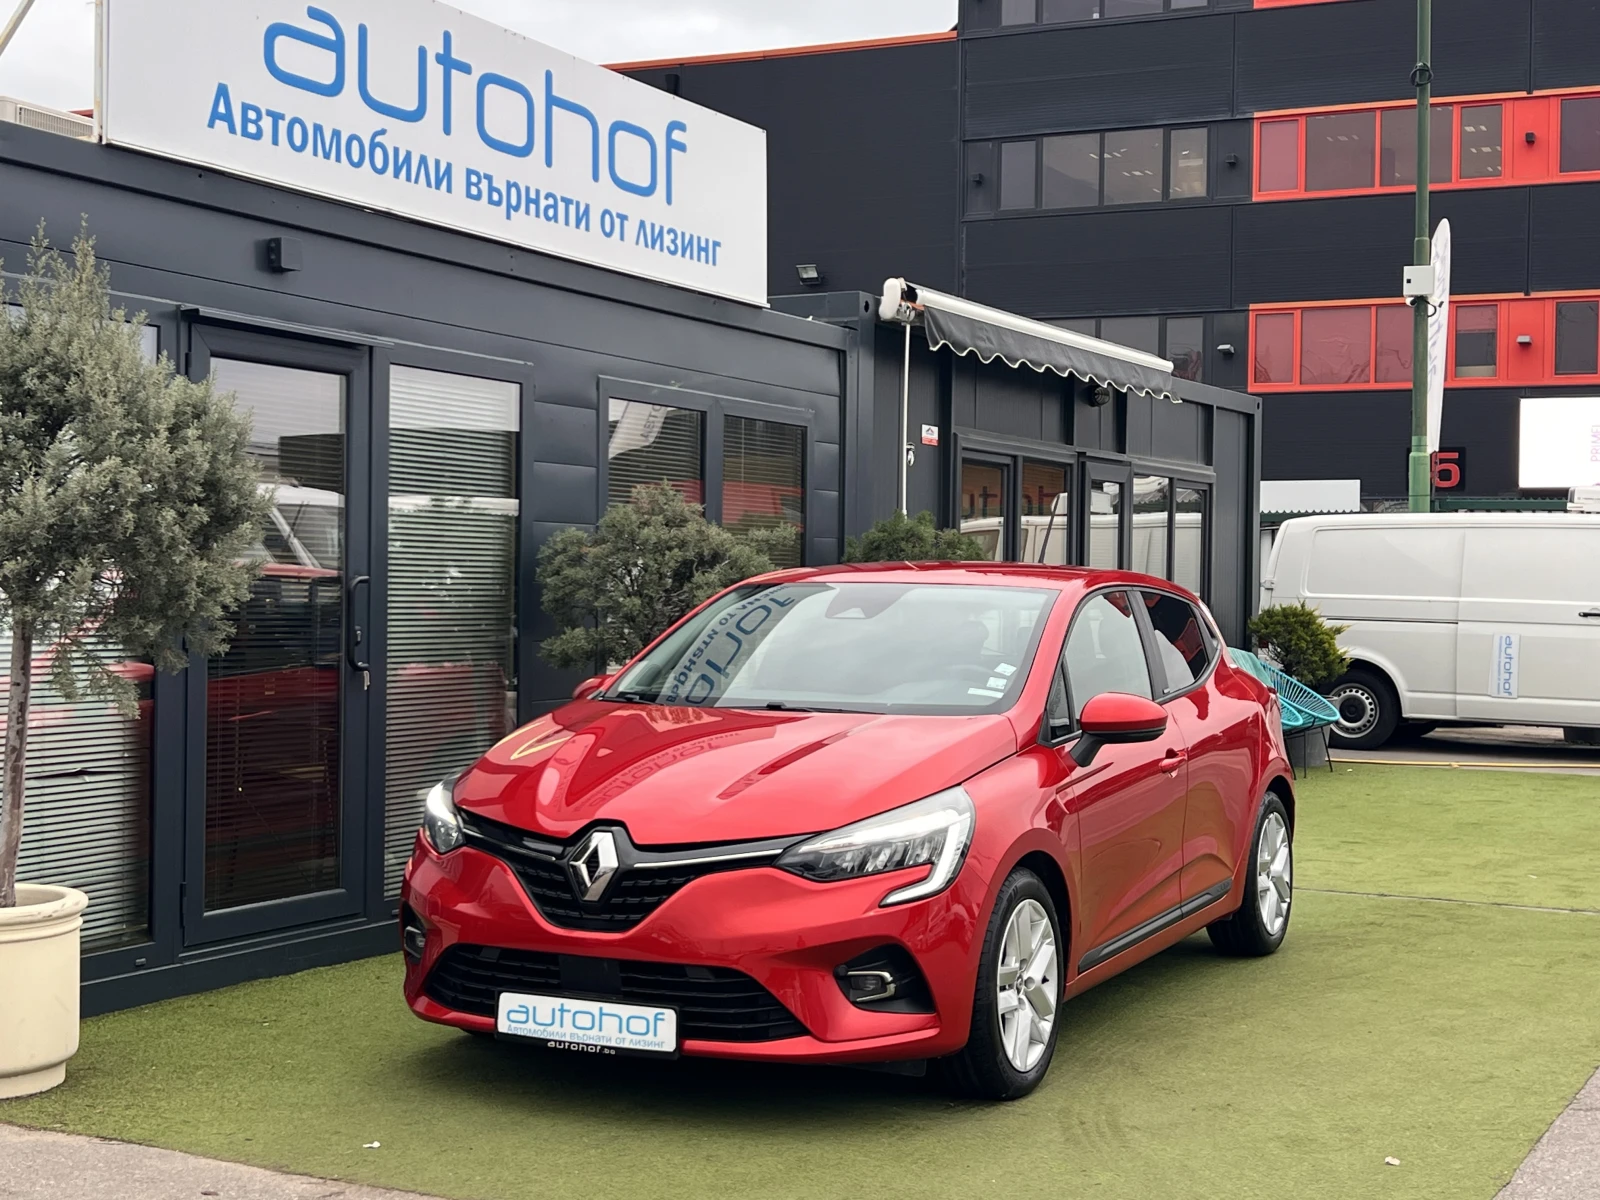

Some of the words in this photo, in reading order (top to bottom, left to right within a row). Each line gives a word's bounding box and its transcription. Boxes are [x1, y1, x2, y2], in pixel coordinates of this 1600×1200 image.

[264, 6, 687, 205] autohof
[207, 82, 453, 194] Автомобили
[465, 165, 591, 234] върнати
[600, 209, 629, 242] от
[635, 223, 721, 267] лизинг
[1503, 635, 1514, 697] autohof
[506, 1003, 665, 1037] autohof
[507, 1024, 567, 1039] Автомобили
[570, 1031, 612, 1045] върнати
[615, 1036, 626, 1045] от
[628, 1038, 665, 1049] лизинг
